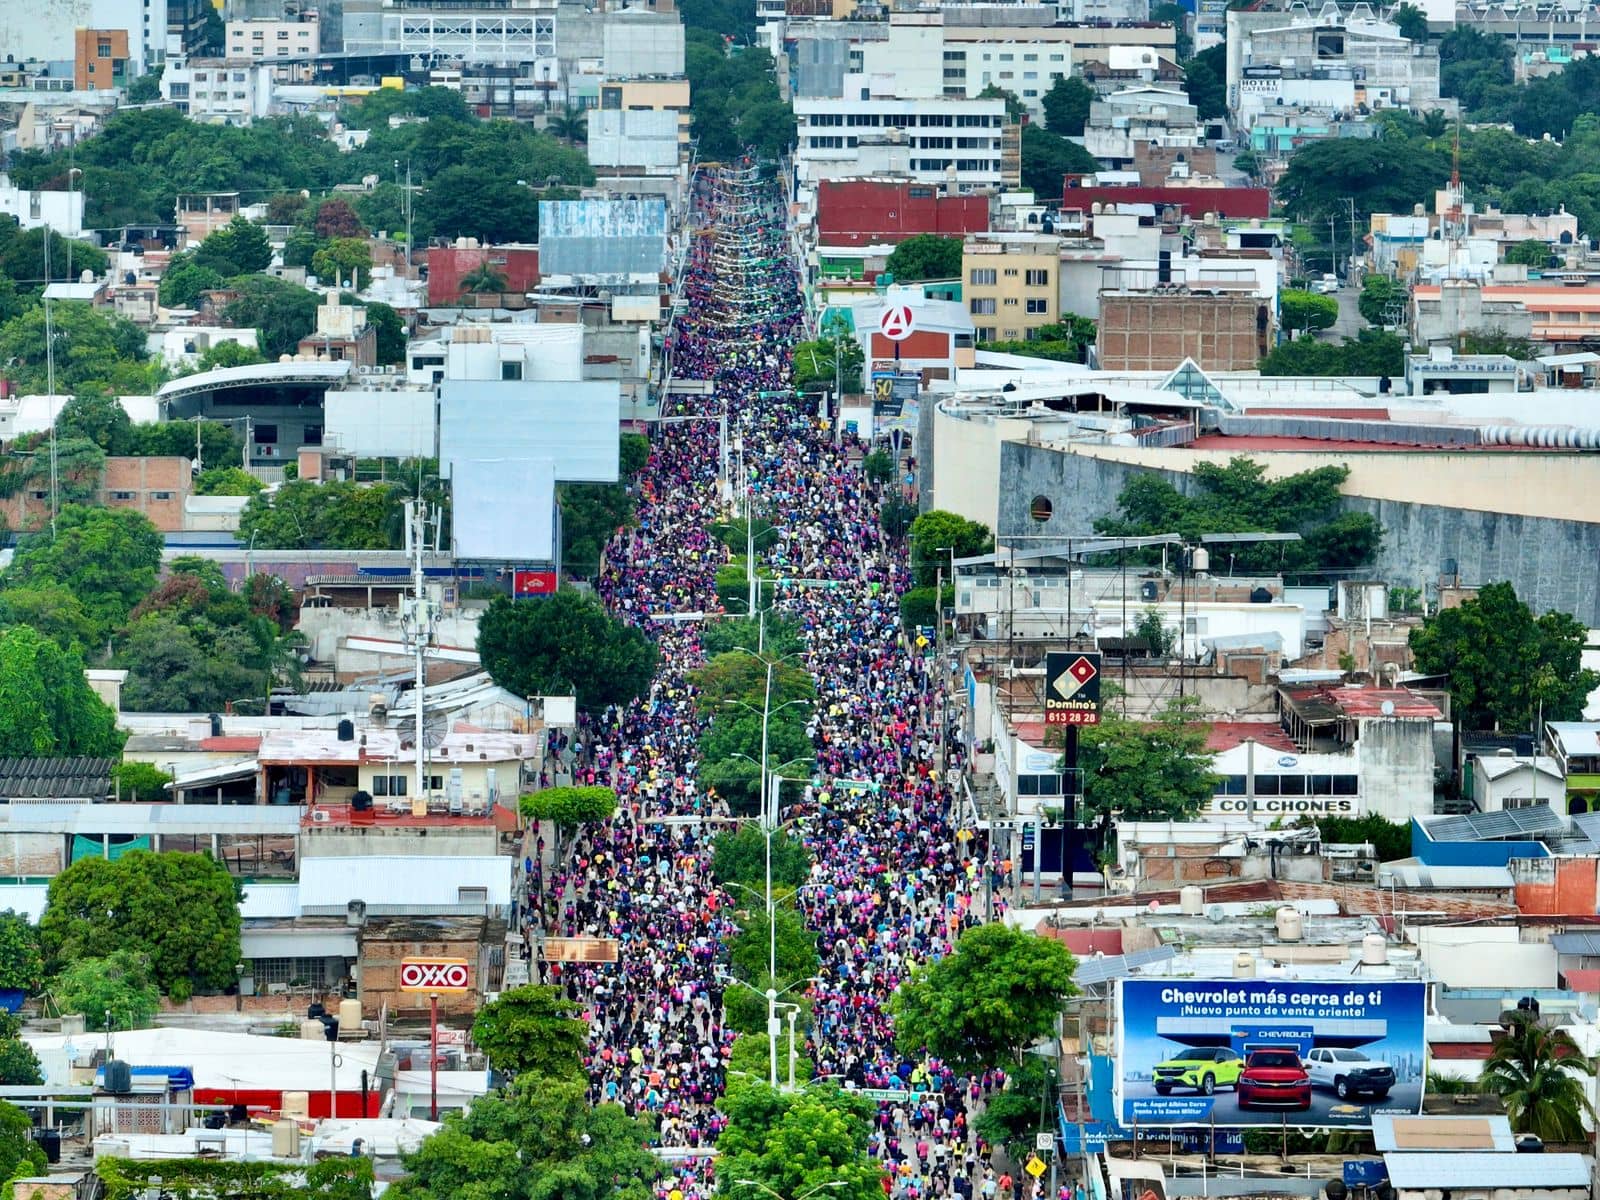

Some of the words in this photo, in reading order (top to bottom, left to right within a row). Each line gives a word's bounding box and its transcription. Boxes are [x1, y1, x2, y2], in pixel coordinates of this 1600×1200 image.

[1046, 699, 1097, 710] Domino's
[1048, 712, 1067, 722] 613
[1069, 713, 1081, 722] 28
[1083, 713, 1096, 723] 28
[1220, 800, 1351, 811] COLCHONES
[402, 963, 467, 988] OXXO
[1161, 988, 1246, 1004] Chevrolet
[1250, 989, 1287, 1005] más
[1290, 992, 1340, 1006] cerca
[1343, 991, 1365, 1006] de
[1368, 990, 1382, 1006] ti
[1181, 1005, 1222, 1017] ¡Nuevo
[1226, 1006, 1261, 1017] punto
[1263, 1006, 1278, 1015] de
[1281, 1007, 1315, 1017] venta
[1318, 1007, 1366, 1017] oriente!
[451, 1032, 464, 1041] 24
